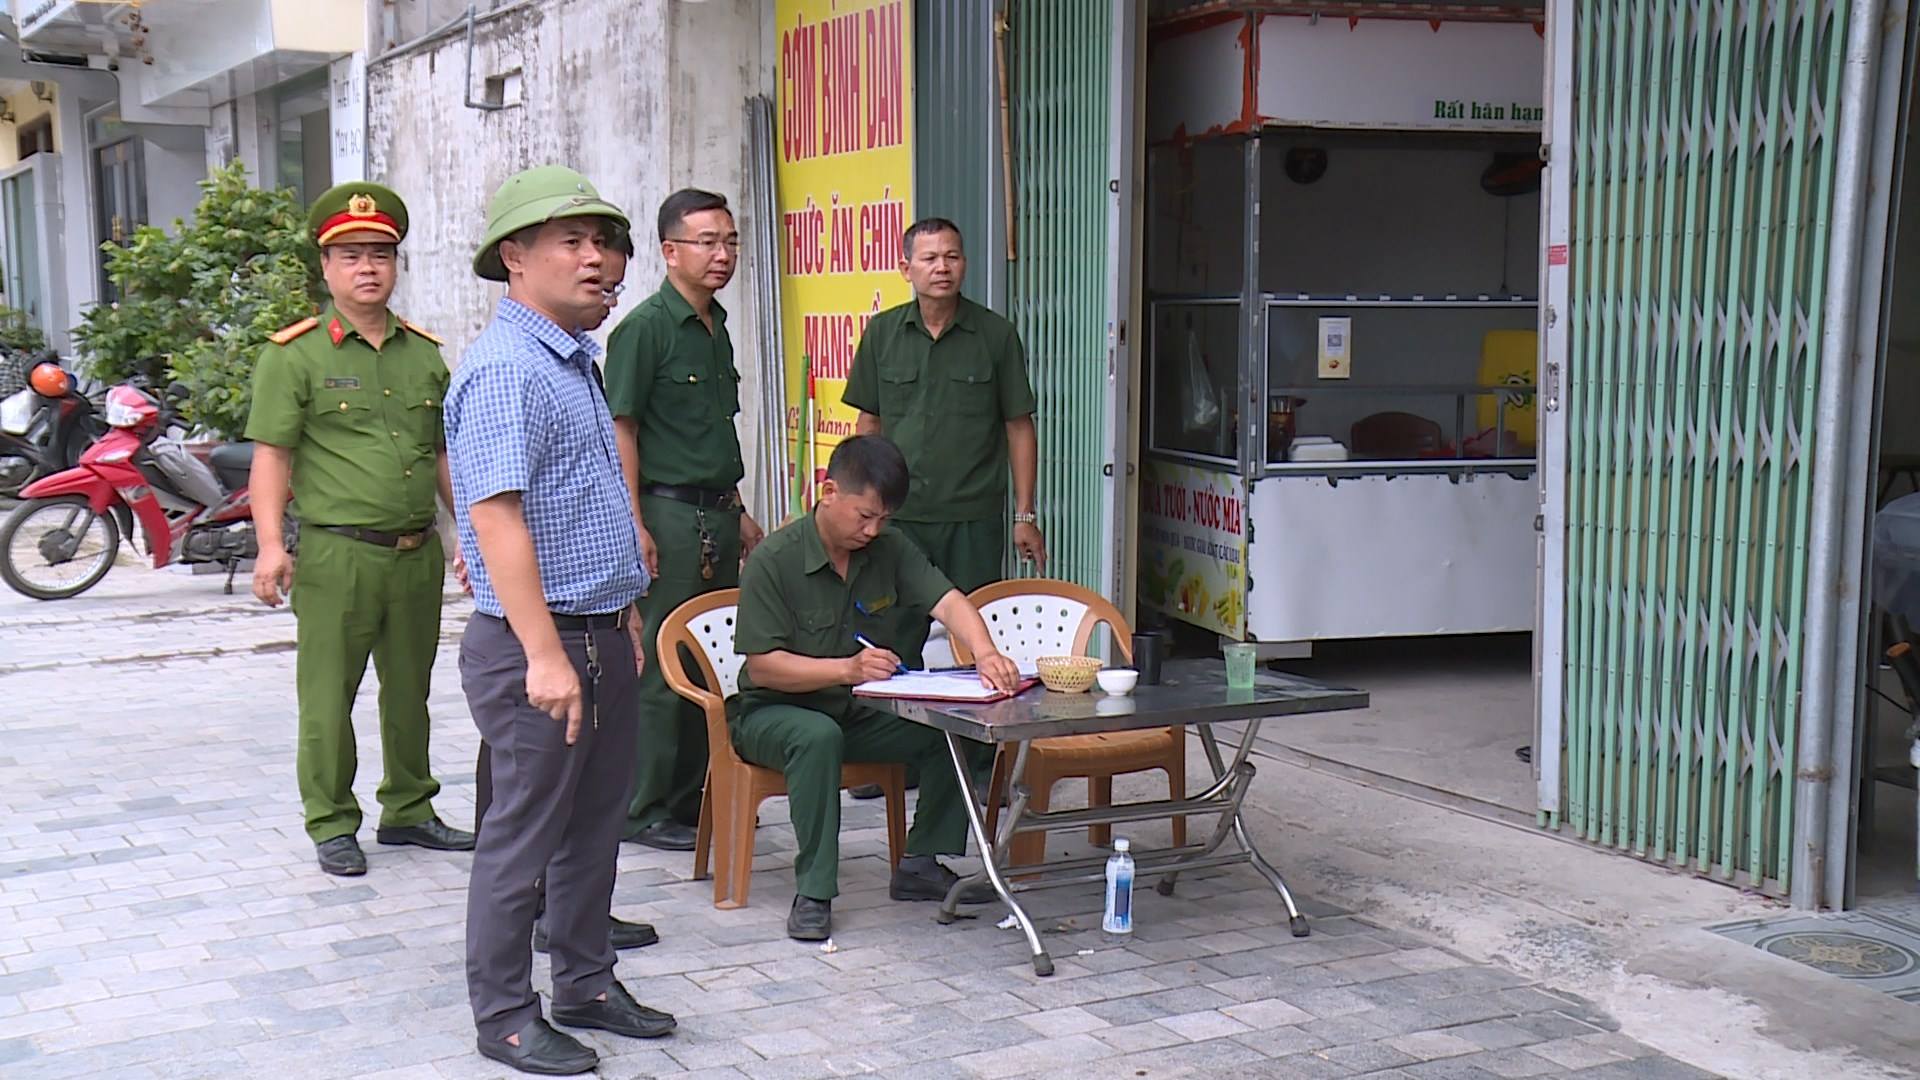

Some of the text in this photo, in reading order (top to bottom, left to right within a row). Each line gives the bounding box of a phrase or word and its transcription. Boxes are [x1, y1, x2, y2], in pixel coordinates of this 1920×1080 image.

[1434, 99, 1464, 119] Rất
[1471, 101, 1504, 120] hân
[784, 188, 903, 275] THỨC ĂN CHÍN
[804, 314, 854, 379] MANG
[1223, 487, 1241, 535] MÍA
